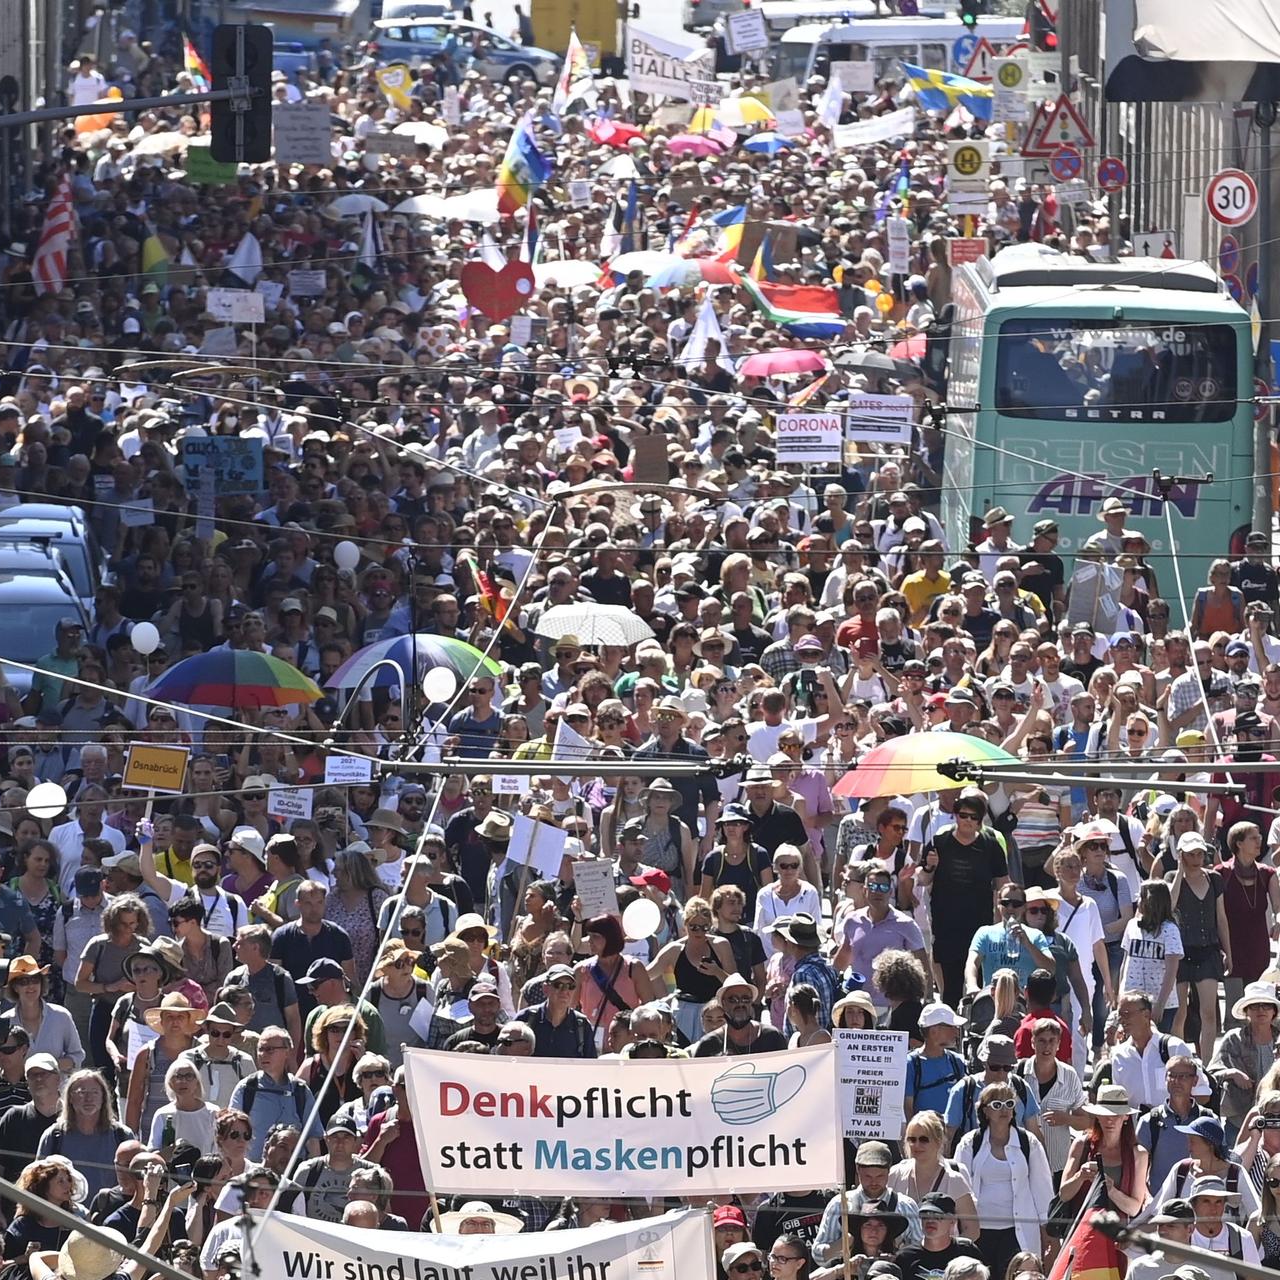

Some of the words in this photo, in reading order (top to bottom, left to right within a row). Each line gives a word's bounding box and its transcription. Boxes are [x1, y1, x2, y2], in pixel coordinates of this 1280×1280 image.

[1217, 185, 1246, 210] 30
[1064, 409, 1166, 421] SETRA
[777, 418, 840, 432] CORONA
[997, 439, 1230, 484] REISEN
[132, 759, 179, 776] Osnabrück
[839, 1032, 903, 1043] GRUNDRECHTE
[861, 1044, 895, 1053] ERSTER
[850, 1055, 882, 1064] STELLE
[857, 1069, 884, 1077] FREIER
[840, 1077, 899, 1087] IMPFENTSCHEID
[438, 1081, 693, 1125] Denkpflicht
[855, 1096, 880, 1106] KEINE
[851, 1119, 863, 1127] TV
[864, 1119, 881, 1127] AUS
[845, 1129, 866, 1138] HIRN
[868, 1129, 880, 1138] AN
[439, 1136, 524, 1170] statt
[535, 1130, 807, 1178] Maskenpflicht
[283, 1250, 335, 1280] Wir
